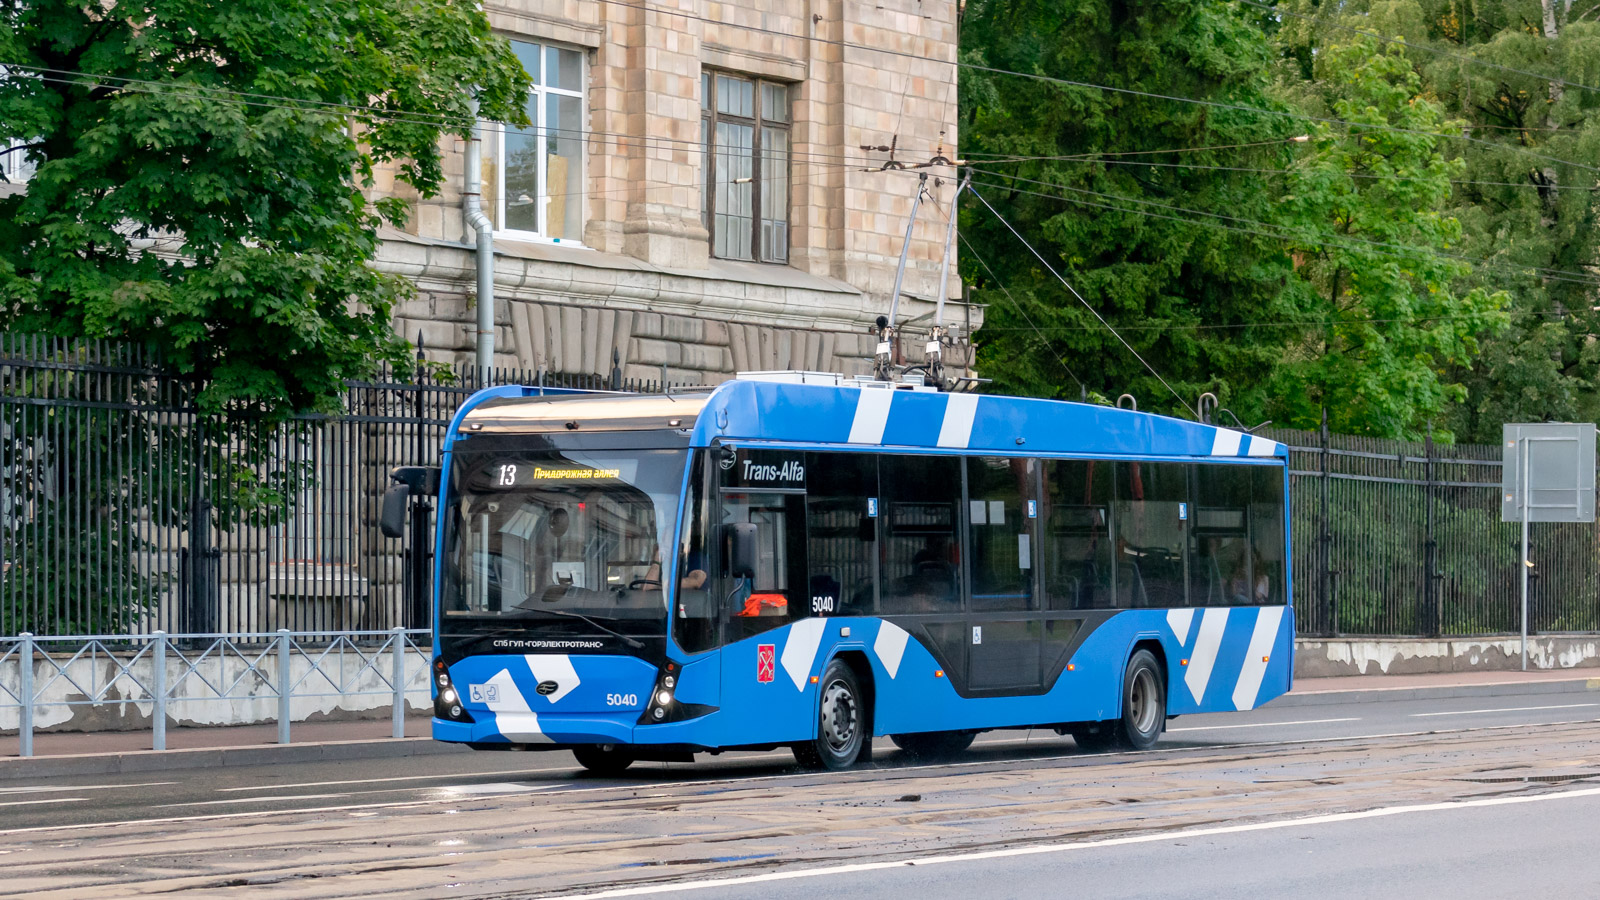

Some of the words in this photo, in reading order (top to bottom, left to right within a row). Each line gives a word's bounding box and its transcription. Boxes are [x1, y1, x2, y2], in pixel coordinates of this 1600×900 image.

[499, 464, 517, 486] 13
[533, 467, 592, 480] Придорожная
[593, 468, 620, 479] аллея
[743, 459, 804, 482] Trans-Alfa
[812, 596, 834, 613] 5040
[493, 639, 508, 648] СПб
[509, 640, 524, 648] ГУП
[524, 640, 604, 649] «ГОРЭЛЕКТРОТРАНС»
[606, 693, 638, 707] 5040
